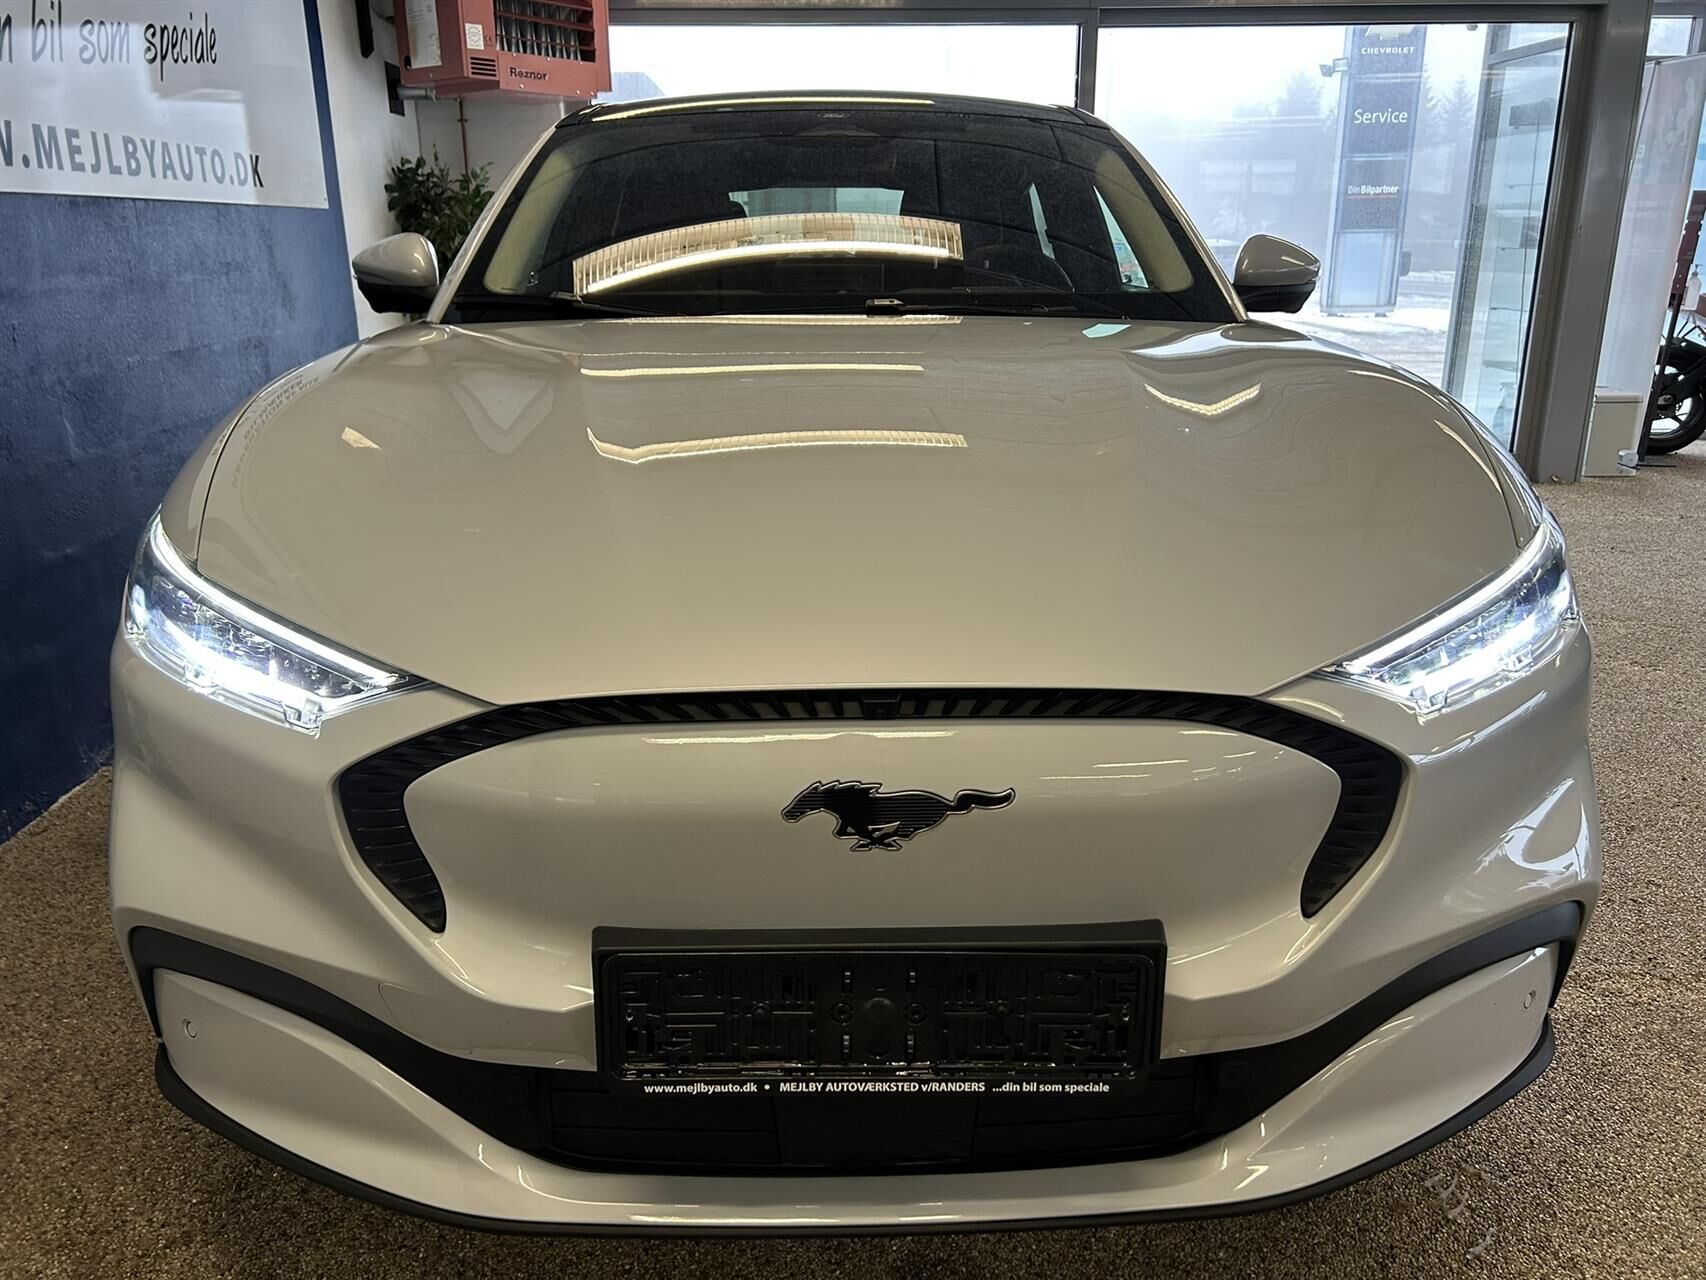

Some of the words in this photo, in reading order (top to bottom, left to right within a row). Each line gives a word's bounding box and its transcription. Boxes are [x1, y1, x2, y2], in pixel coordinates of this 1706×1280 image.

[31, 0, 63, 63] bil
[79, 18, 130, 65] som
[143, 12, 217, 82] speciale
[1361, 46, 1415, 55] CHEVROLET
[509, 66, 548, 81] Reznor
[1354, 108, 1408, 124] Service
[644, 1082, 757, 1095] www.mejlbyauto.dk
[780, 1082, 823, 1092] MEJLBY
[825, 1082, 919, 1092] AUTOVÆRKSTED
[921, 1082, 985, 1092] v/RANDERS
[992, 1082, 1020, 1092] ...din
[1022, 1082, 1036, 1092] bil
[1038, 1084, 1062, 1092] som
[1064, 1082, 1110, 1094] speciale
